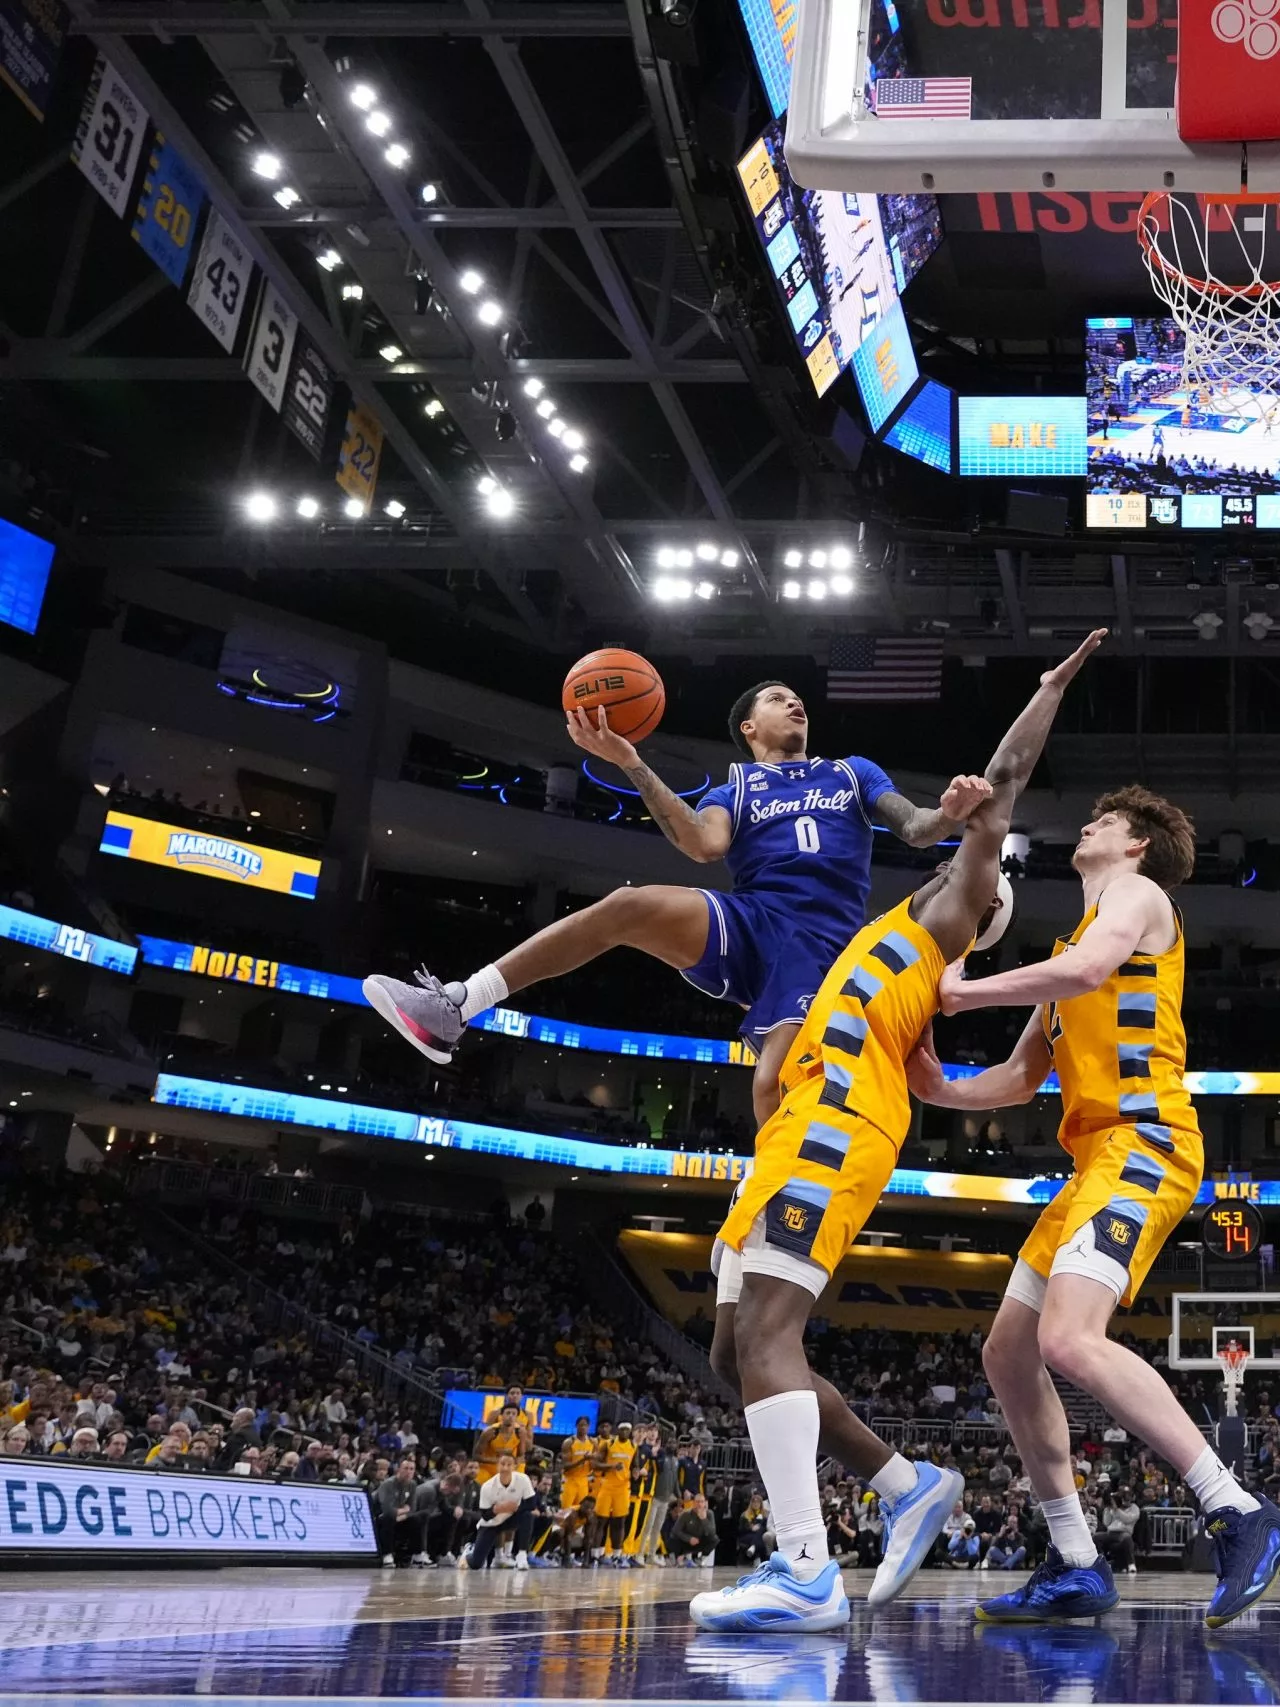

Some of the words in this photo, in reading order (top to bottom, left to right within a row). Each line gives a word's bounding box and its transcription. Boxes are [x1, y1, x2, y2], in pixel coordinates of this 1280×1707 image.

[94, 101, 134, 182] 31
[154, 184, 191, 248] 20
[207, 257, 240, 315] 43
[263, 320, 285, 373] 3
[294, 367, 327, 427] 22
[989, 422, 1058, 450] MAKE
[1108, 498, 1122, 509] 10
[1226, 498, 1253, 512] 45.5
[573, 675, 626, 699] ELITE
[750, 799, 801, 824] Seton
[803, 788, 854, 811] Hall
[794, 816, 821, 854] 0
[167, 833, 263, 876] MARQUETTE
[190, 945, 279, 988] NOISE!
[1214, 1182, 1260, 1200] MAKE
[781, 1203, 808, 1233] MU
[1105, 1218, 1131, 1247] MU
[1212, 1211, 1243, 1227] 45.3
[1226, 1226, 1249, 1253] 14
[483, 1394, 556, 1430] MKE
[5, 1479, 134, 1537] EDGE
